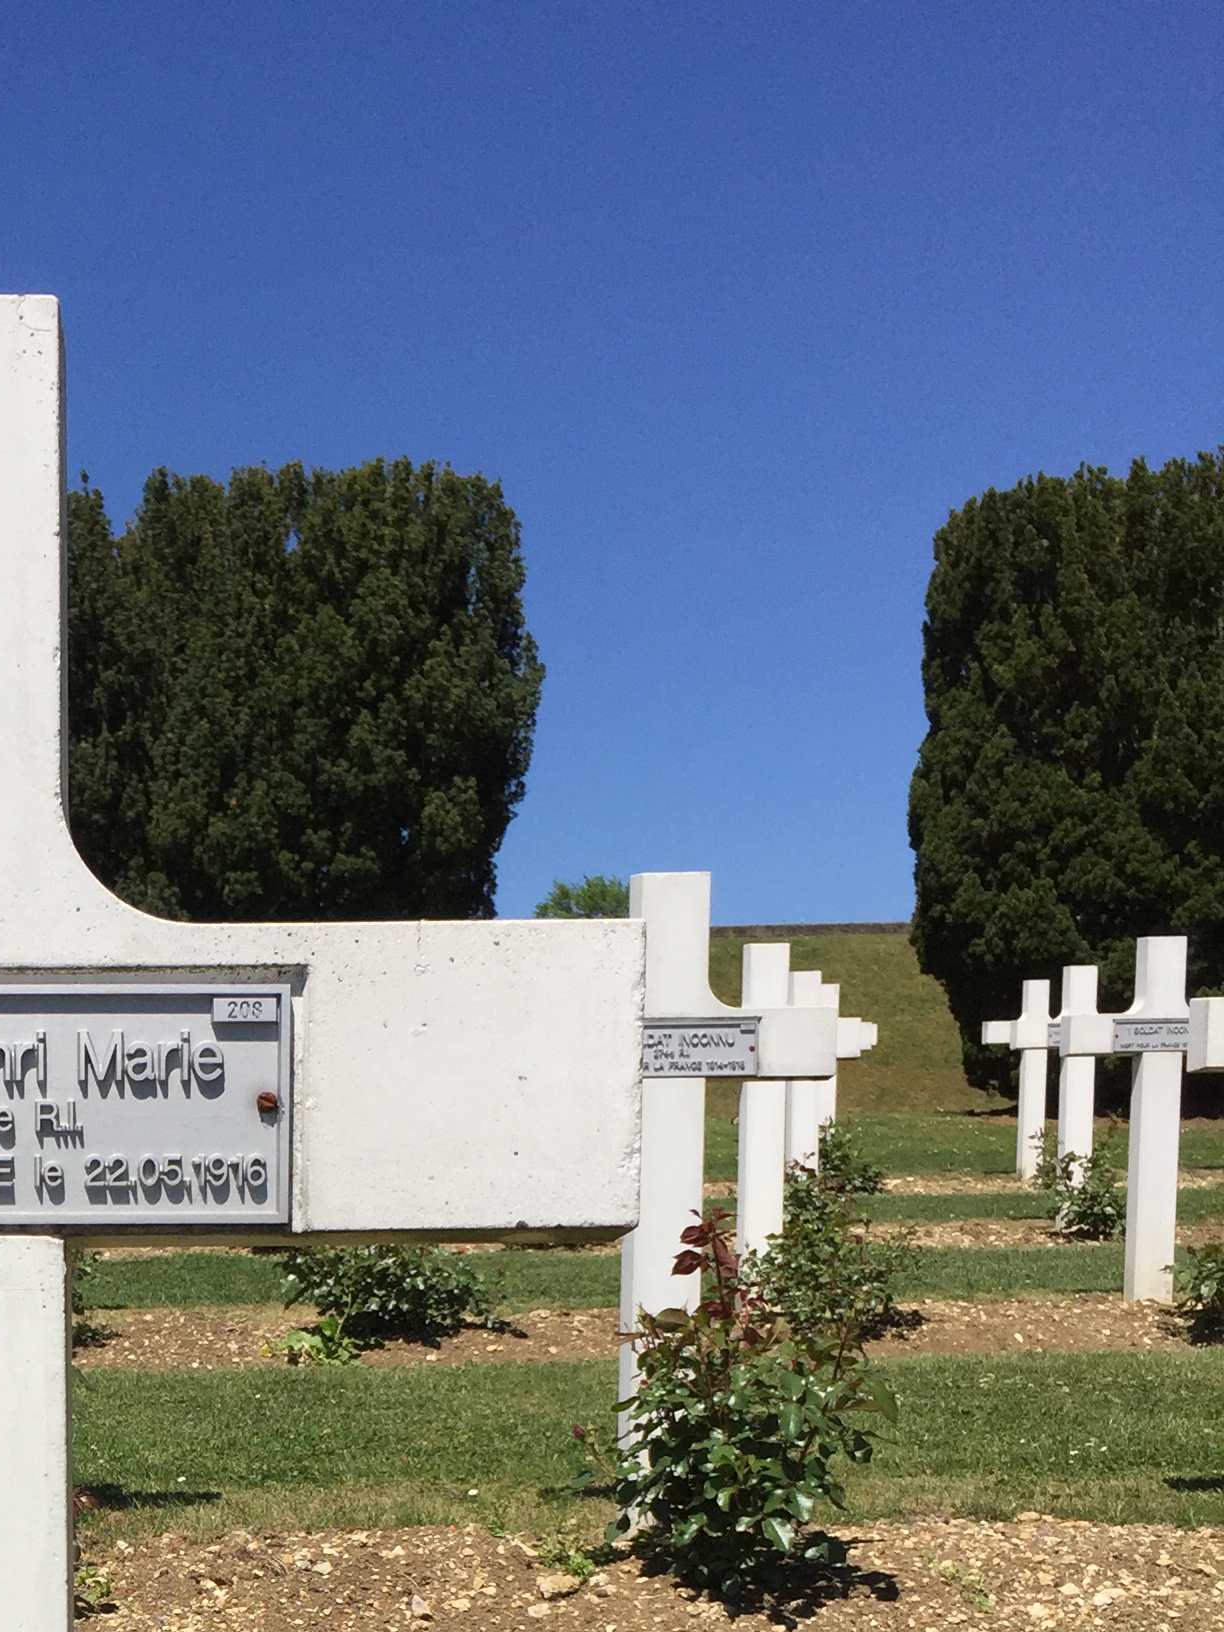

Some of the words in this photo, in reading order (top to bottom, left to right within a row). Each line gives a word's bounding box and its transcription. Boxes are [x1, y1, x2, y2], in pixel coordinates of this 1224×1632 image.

[226, 1000, 264, 1019] 208
[643, 1033, 673, 1049] DAT
[76, 1029, 224, 1083] Marie
[669, 1061, 703, 1072] FRANCE
[34, 1099, 84, 1132] R.I.
[33, 1154, 64, 1187] le
[84, 1153, 268, 1187] 22.05.1916
